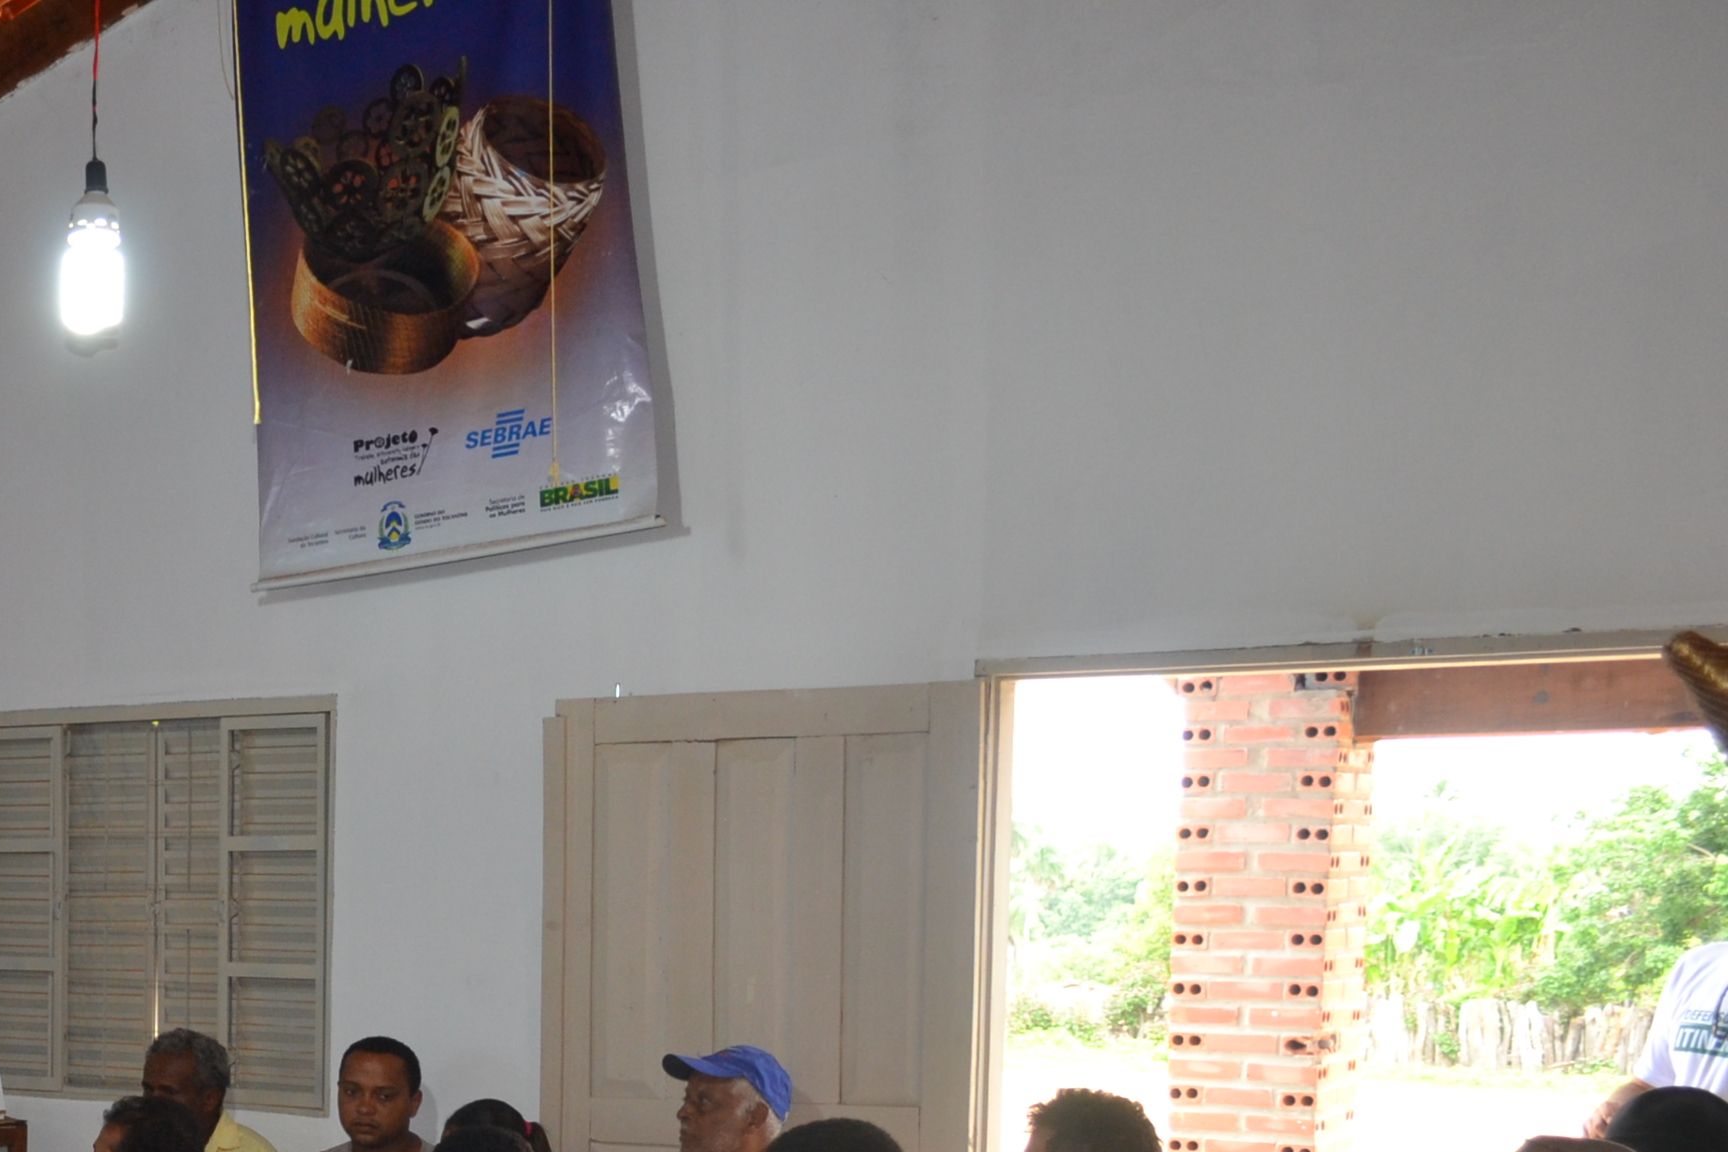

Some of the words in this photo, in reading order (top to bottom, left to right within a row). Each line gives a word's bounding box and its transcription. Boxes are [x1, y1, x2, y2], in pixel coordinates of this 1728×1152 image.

[353, 429, 418, 453] Projeto
[465, 417, 553, 449] SEBRAE
[354, 462, 417, 487] mulheres
[539, 476, 619, 508] BRASIL
